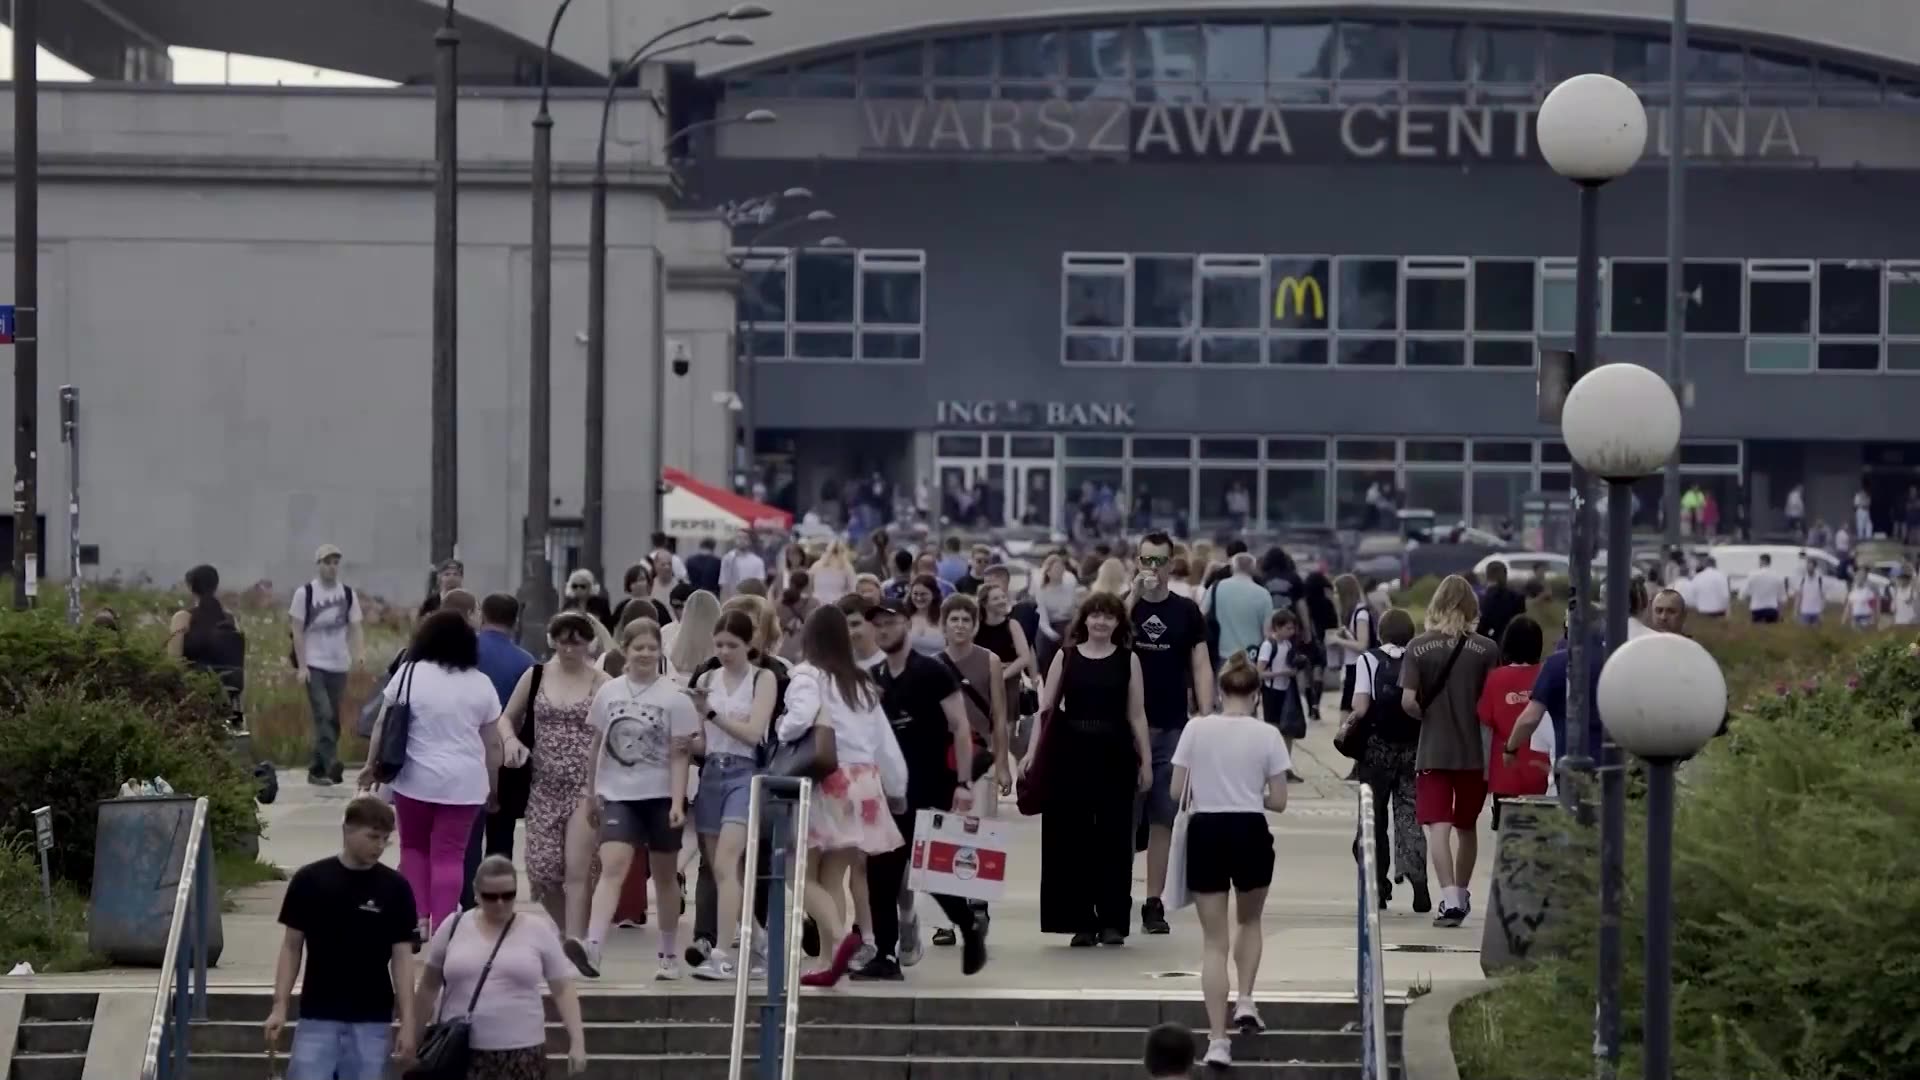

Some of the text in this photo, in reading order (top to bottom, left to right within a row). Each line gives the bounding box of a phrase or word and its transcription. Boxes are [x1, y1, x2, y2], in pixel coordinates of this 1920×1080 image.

[864, 102, 1801, 157] WARSZAWA CENTLNA
[937, 401, 1135, 424] ING BANK
[671, 519, 716, 529] PEPSI
